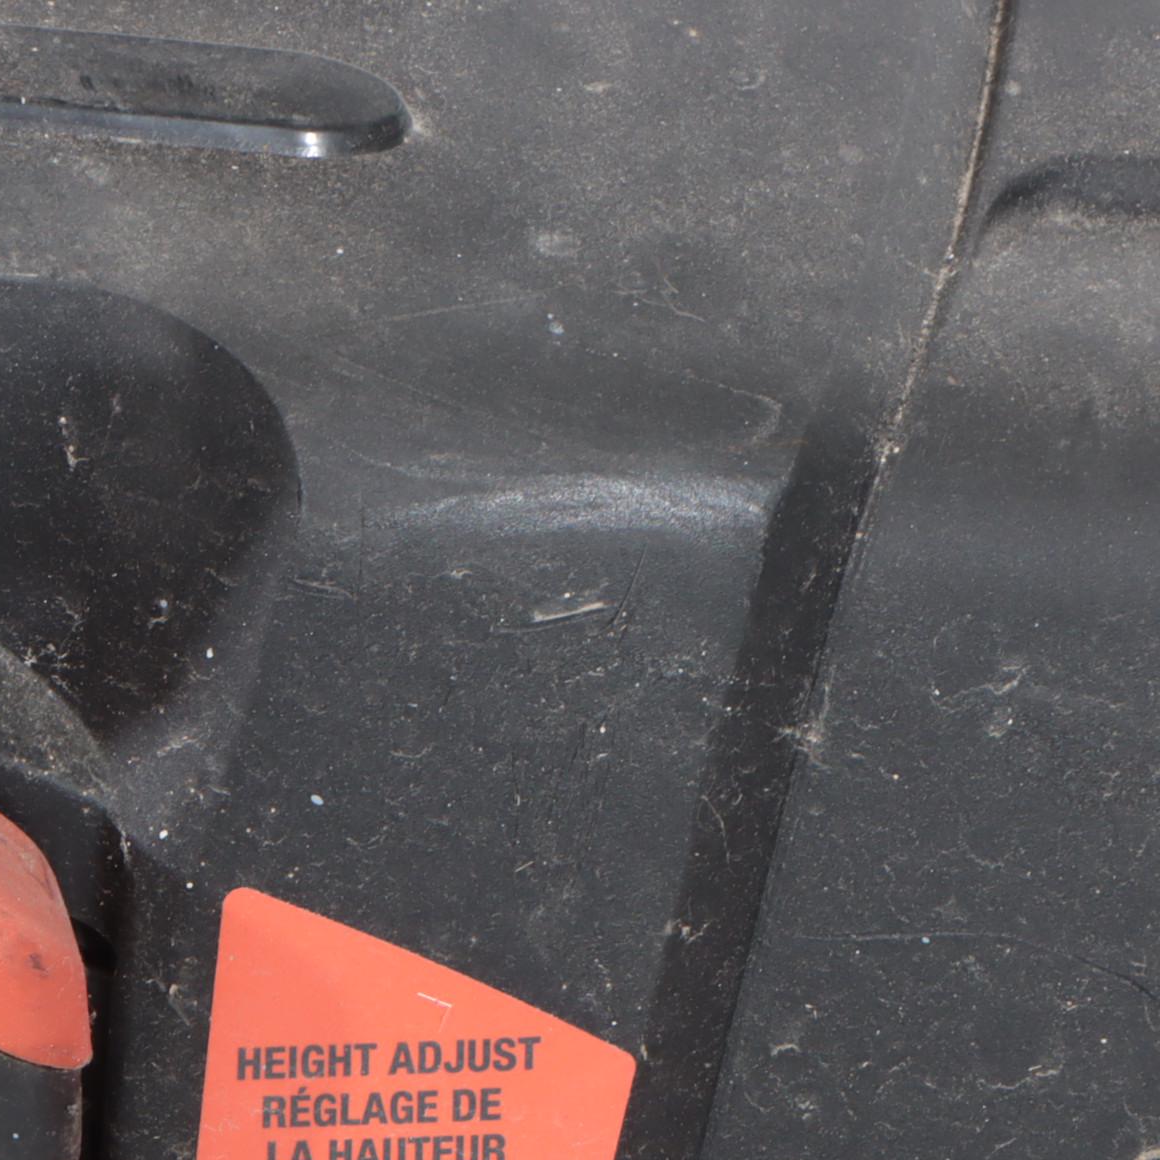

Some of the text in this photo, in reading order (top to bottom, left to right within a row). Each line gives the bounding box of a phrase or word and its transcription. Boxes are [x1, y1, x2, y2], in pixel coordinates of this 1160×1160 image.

[238, 1037, 542, 1080] HEIGHT ADJUST
[262, 1087, 502, 1128] RÉGLAGE DE
